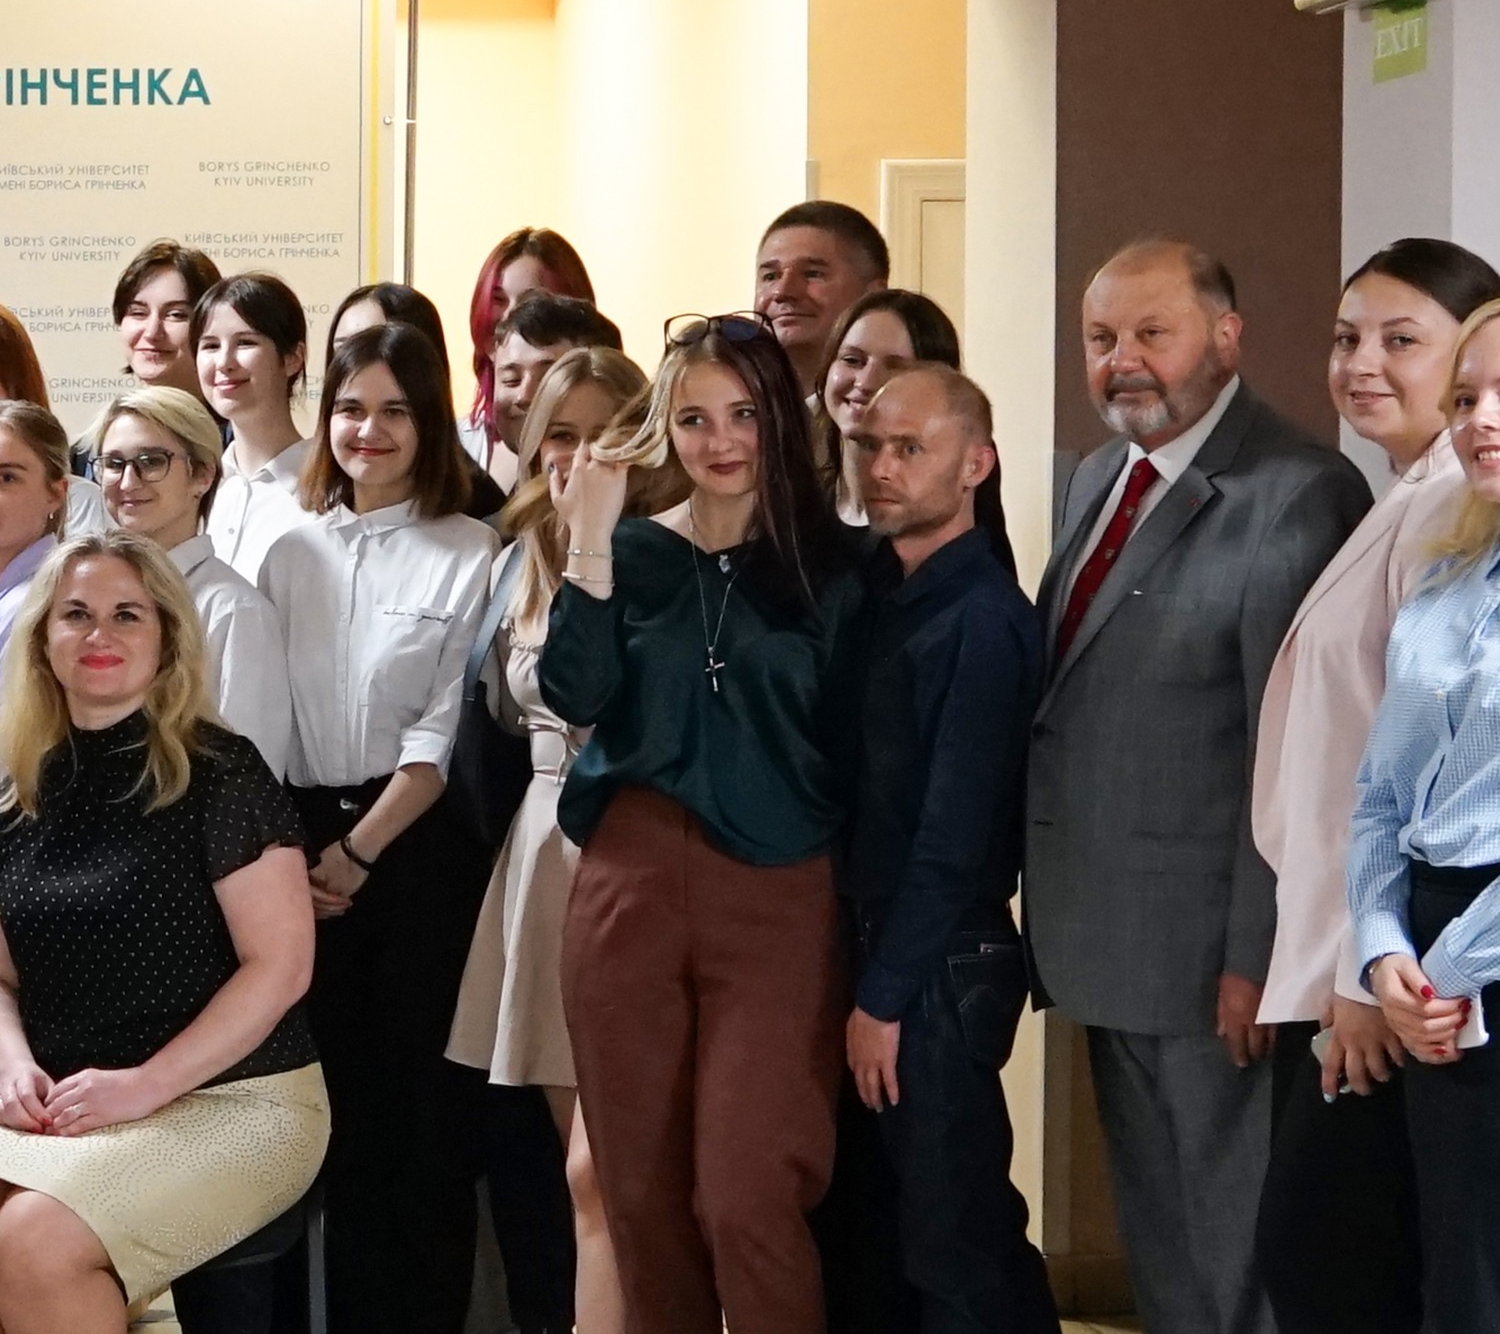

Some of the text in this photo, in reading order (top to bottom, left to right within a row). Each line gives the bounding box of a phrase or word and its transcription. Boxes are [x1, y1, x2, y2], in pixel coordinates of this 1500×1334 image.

[1375, 18, 1422, 59] EXIT
[68, 165, 149, 176] УНІВЕРСИТЕТ
[199, 161, 331, 172] BORYS GRINCHENKO
[29, 180, 82, 191] БОРИСА
[85, 180, 147, 191] ГРІНЧЕНКА
[214, 176, 314, 187] KYIV UNIVERSITY
[3, 236, 136, 247] BORYS GRINCHENKO
[185, 232, 344, 244] КИЇВСЬКИЙ УНІВЕРСИТЕТ
[19, 251, 120, 261] KYIV UNIVERSITY
[223, 248, 276, 259] БОРИСА
[279, 248, 340, 259] ГРІНЧЕНКА
[69, 307, 111, 318] УНІВЕР
[29, 322, 82, 332] БОРИСА
[49, 378, 136, 388] GRINCHENKO
